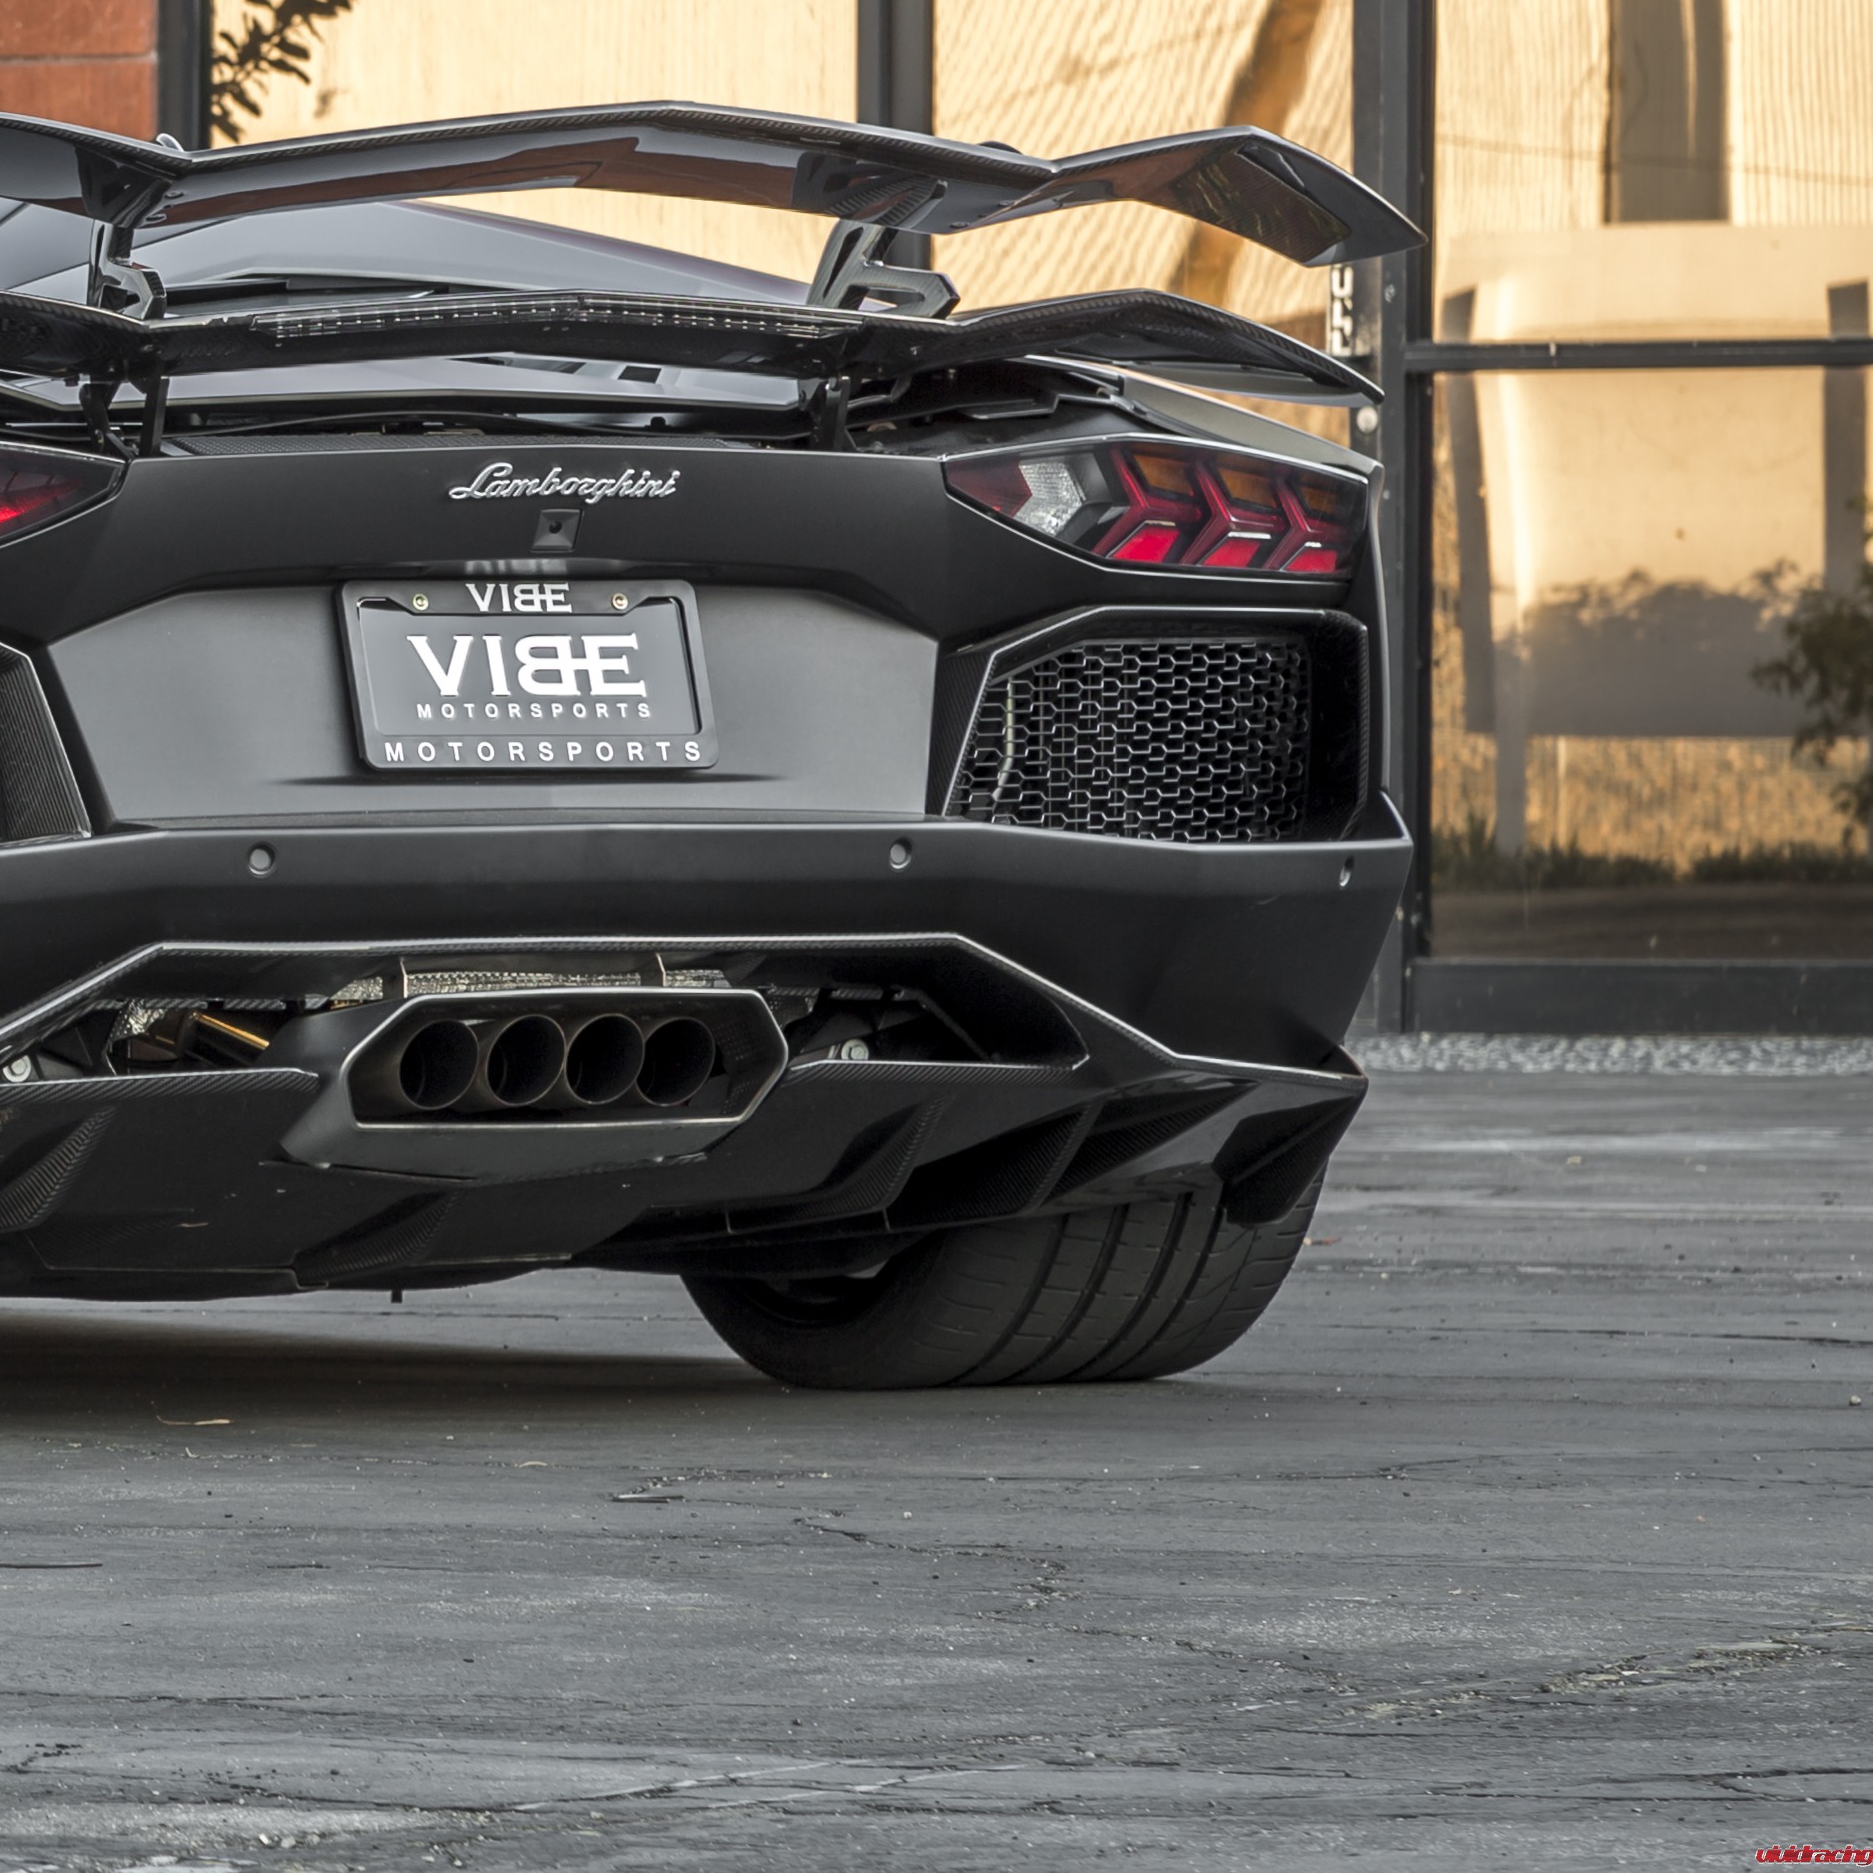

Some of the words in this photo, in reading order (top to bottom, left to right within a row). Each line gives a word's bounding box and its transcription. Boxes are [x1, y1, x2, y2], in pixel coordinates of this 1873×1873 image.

[1332, 264, 1354, 357] ULL
[449, 462, 681, 504] Lamborghini
[465, 582, 573, 613] VIBE
[406, 632, 648, 698] VIBE
[416, 702, 651, 719] MOTORSPORTS
[384, 741, 701, 762] MOTORSPORTS
